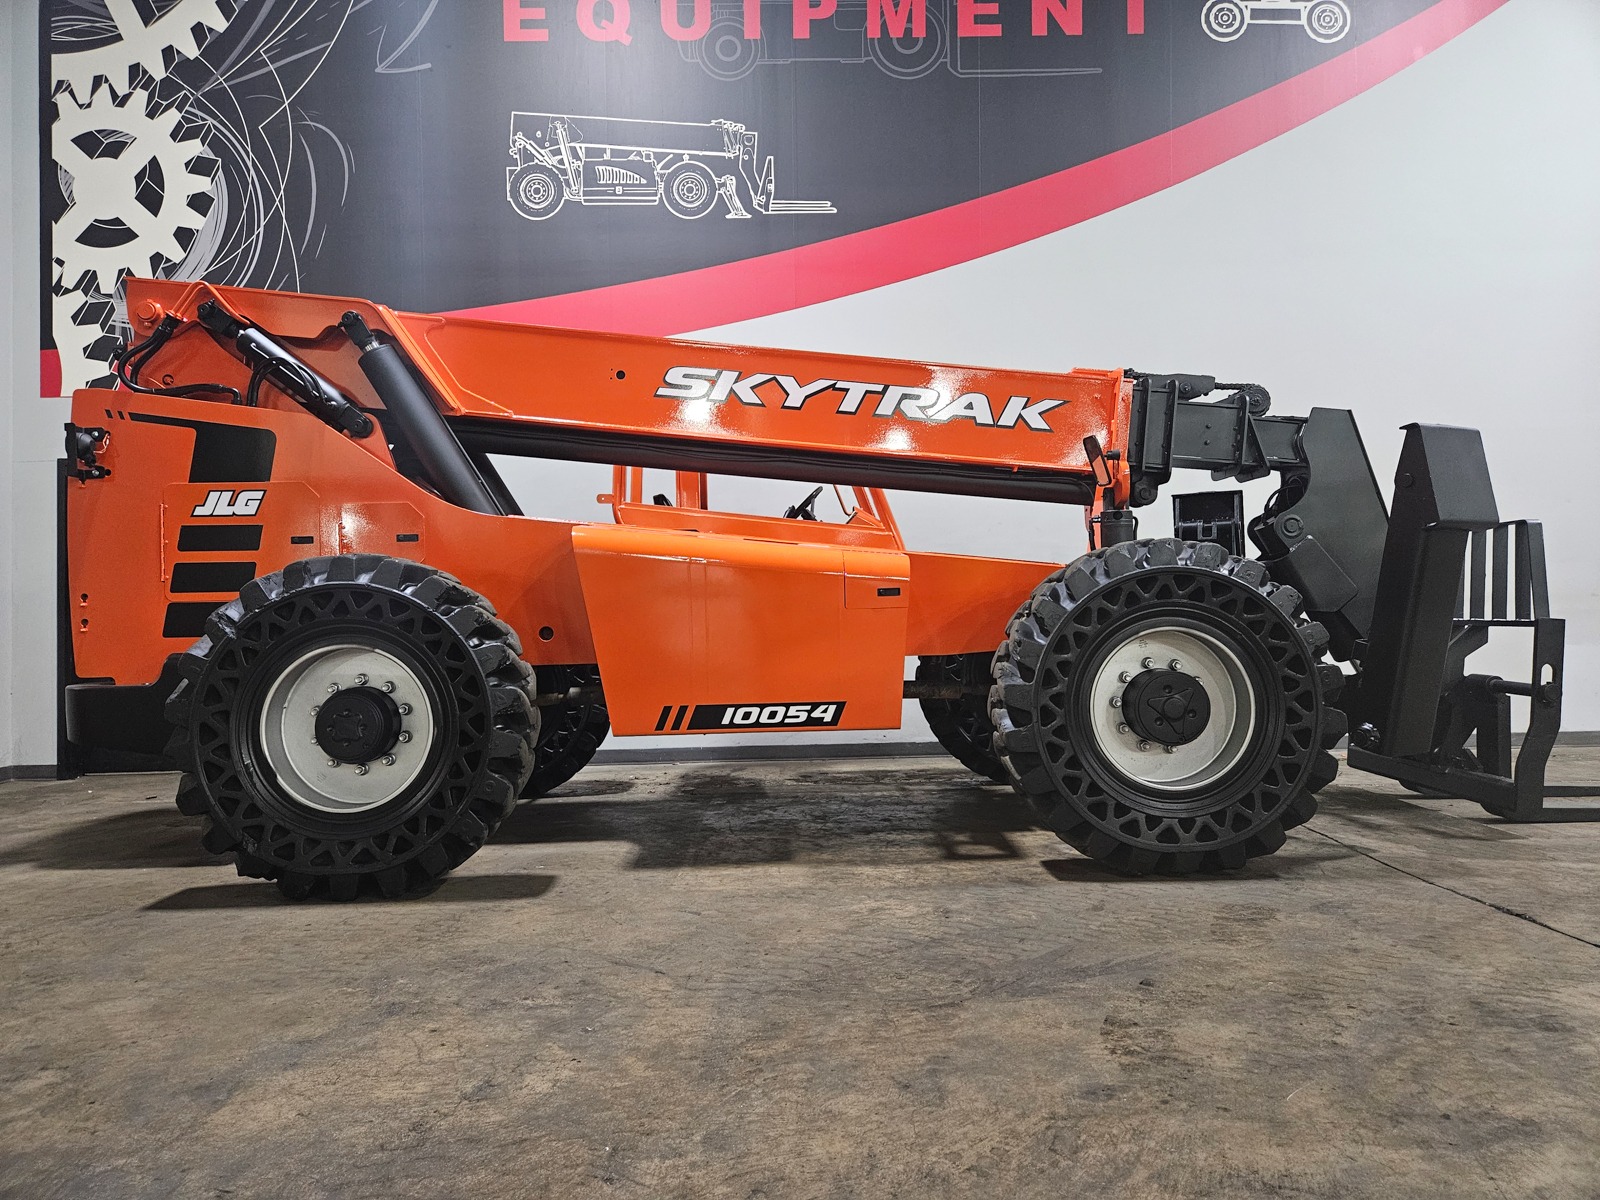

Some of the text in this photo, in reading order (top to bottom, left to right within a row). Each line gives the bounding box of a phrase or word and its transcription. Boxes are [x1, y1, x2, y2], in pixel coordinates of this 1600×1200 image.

[655, 366, 1070, 432] SKYTRAK
[191, 490, 267, 517] JLG
[721, 704, 837, 725] 10054
